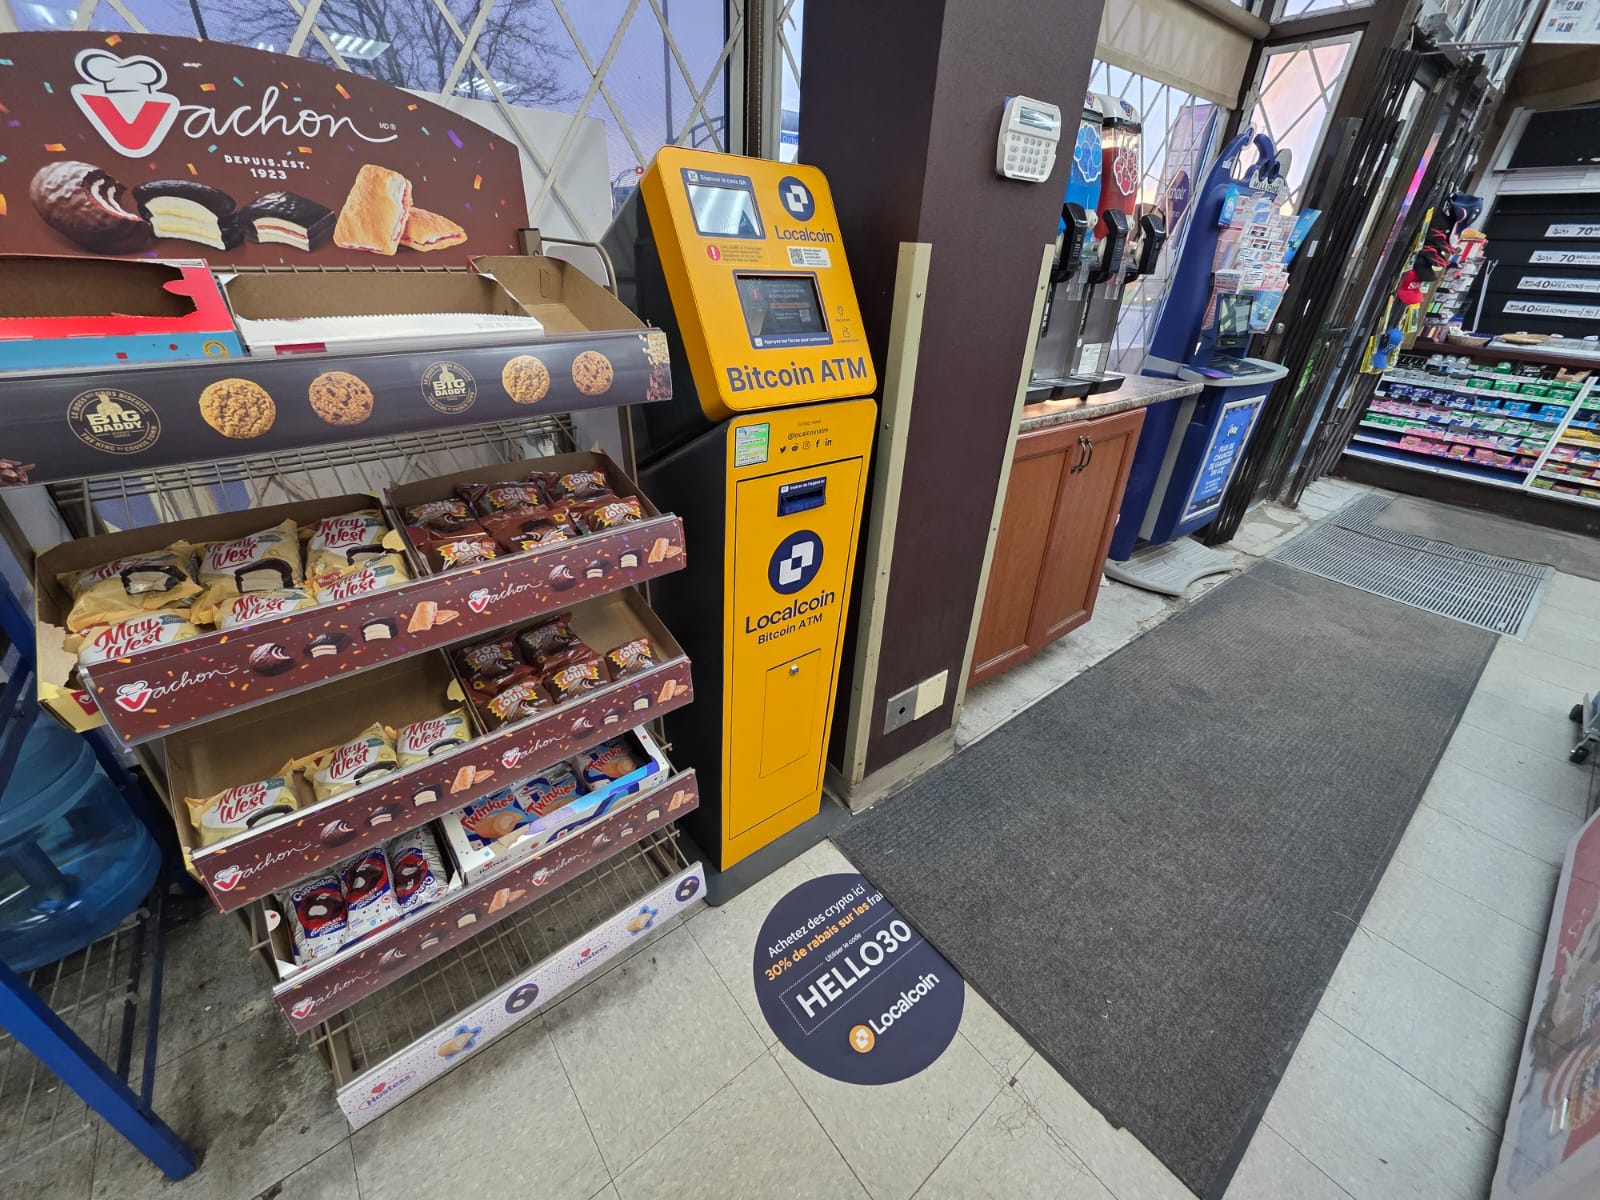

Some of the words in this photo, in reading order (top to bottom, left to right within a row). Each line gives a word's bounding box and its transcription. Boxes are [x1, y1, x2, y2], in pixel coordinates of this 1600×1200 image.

[71, 80, 398, 157] Vachon
[250, 168, 287, 180] 1923
[774, 225, 835, 243] Localcoin
[1577, 227, 1593, 236] 70
[1560, 254, 1576, 263] 70
[1534, 280, 1551, 289] 40
[1520, 304, 1535, 313] 40
[432, 378, 466, 391] BIG
[726, 362, 815, 393] Bitcoin
[820, 356, 868, 383] ATM
[434, 387, 467, 397] DADDY
[86, 409, 141, 426] BIG
[91, 420, 143, 434] DADDY
[317, 517, 364, 538] May
[325, 528, 367, 546] West
[212, 543, 257, 570] West
[334, 578, 376, 600] West
[468, 577, 543, 613] Vachon
[745, 589, 835, 634] Localcoin
[94, 618, 161, 653] May
[758, 624, 796, 645] Bitcoin
[798, 612, 823, 630] ATM
[106, 627, 164, 660] West
[562, 667, 593, 685] LOUIS
[564, 662, 589, 676] JOS
[115, 664, 238, 712] Vachon
[499, 688, 530, 712] LOUIS
[403, 718, 446, 740] May
[408, 725, 447, 751] West
[329, 741, 368, 768] May
[330, 748, 370, 780] West
[502, 735, 568, 768] Vachon
[217, 781, 265, 811] May
[219, 789, 268, 825] West
[525, 781, 577, 818] Twinkies
[460, 793, 515, 832] Twinkies
[213, 841, 311, 892] Vachon
[532, 850, 587, 886] Vachon
[768, 926, 808, 958] Achetez
[807, 913, 826, 930] des
[824, 893, 854, 917] crypto
[851, 883, 866, 897] ici
[765, 957, 792, 981] 30%
[792, 947, 808, 962] de
[807, 924, 839, 952] rabais
[838, 912, 854, 928] sur
[852, 902, 870, 916] les
[866, 890, 884, 906] frai
[848, 932, 862, 945] code
[576, 943, 610, 967] Hostess
[796, 919, 912, 1018] HELLO30
[291, 972, 372, 1019] Vachon
[868, 971, 940, 1035] Localcoin
[366, 1074, 412, 1105] Hostess
